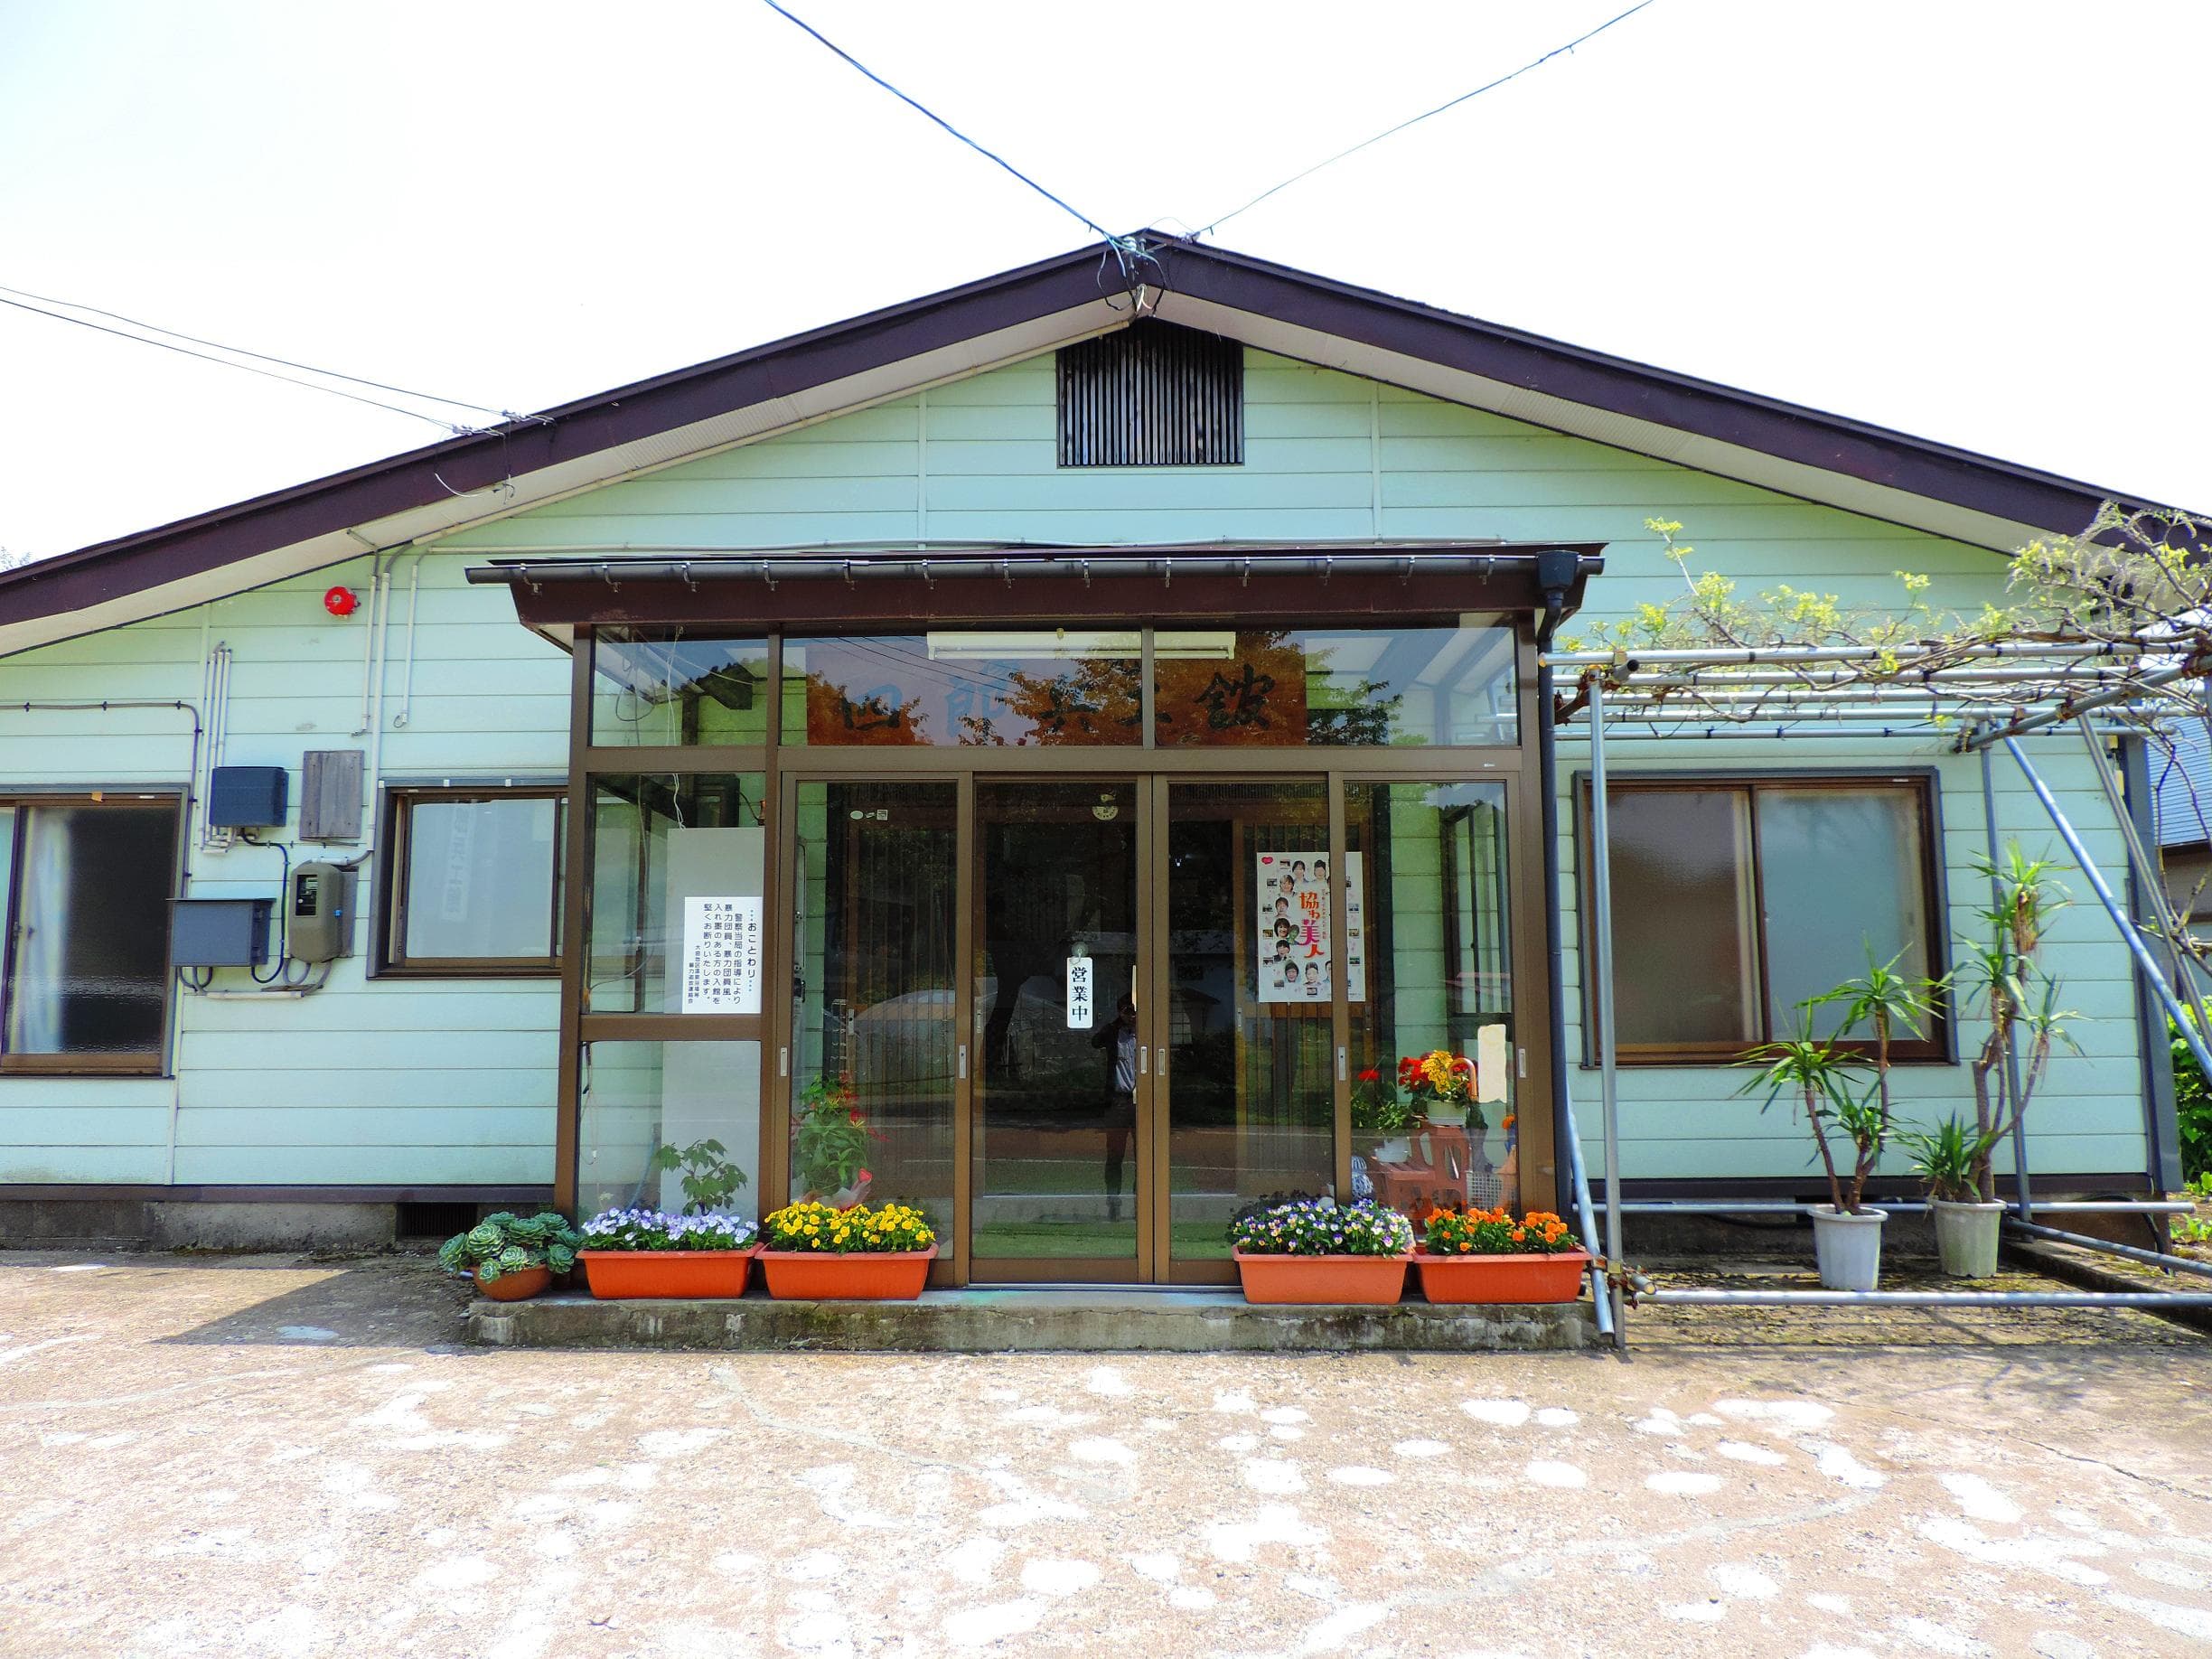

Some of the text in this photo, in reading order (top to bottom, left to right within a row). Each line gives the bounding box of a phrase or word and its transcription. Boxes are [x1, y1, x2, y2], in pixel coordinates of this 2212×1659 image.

[703, 904, 712, 999] 堅くお断りいたします。
[712, 904, 722, 1004] 入れ墨のある方の入館を
[733, 913, 742, 1004] 警察当局の指導により
[747, 923, 756, 979] おことわり
[1071, 966, 1088, 1022] 営業中
